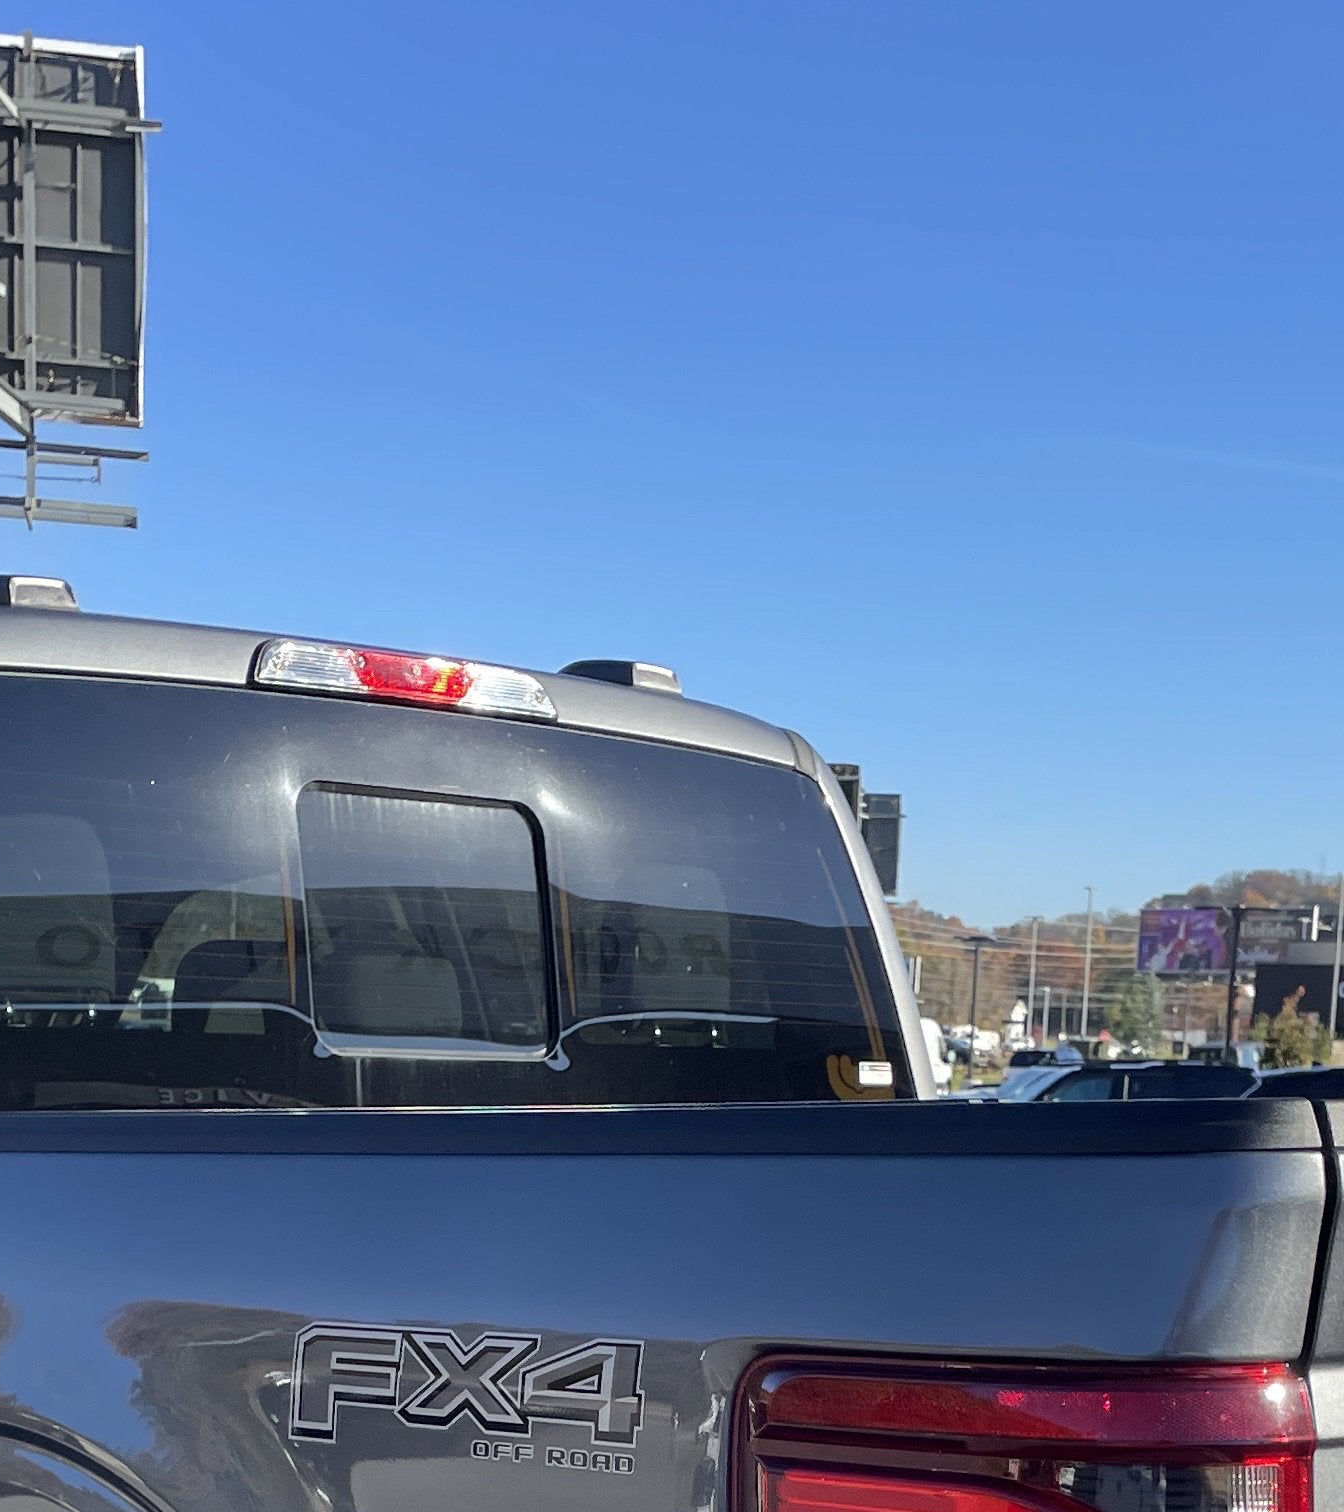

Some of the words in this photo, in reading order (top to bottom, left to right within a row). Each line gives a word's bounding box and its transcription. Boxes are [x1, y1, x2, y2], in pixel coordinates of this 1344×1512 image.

[288, 1321, 646, 1448] FX4
[470, 1439, 535, 1464] OFF
[546, 1446, 636, 1475] ROAD
